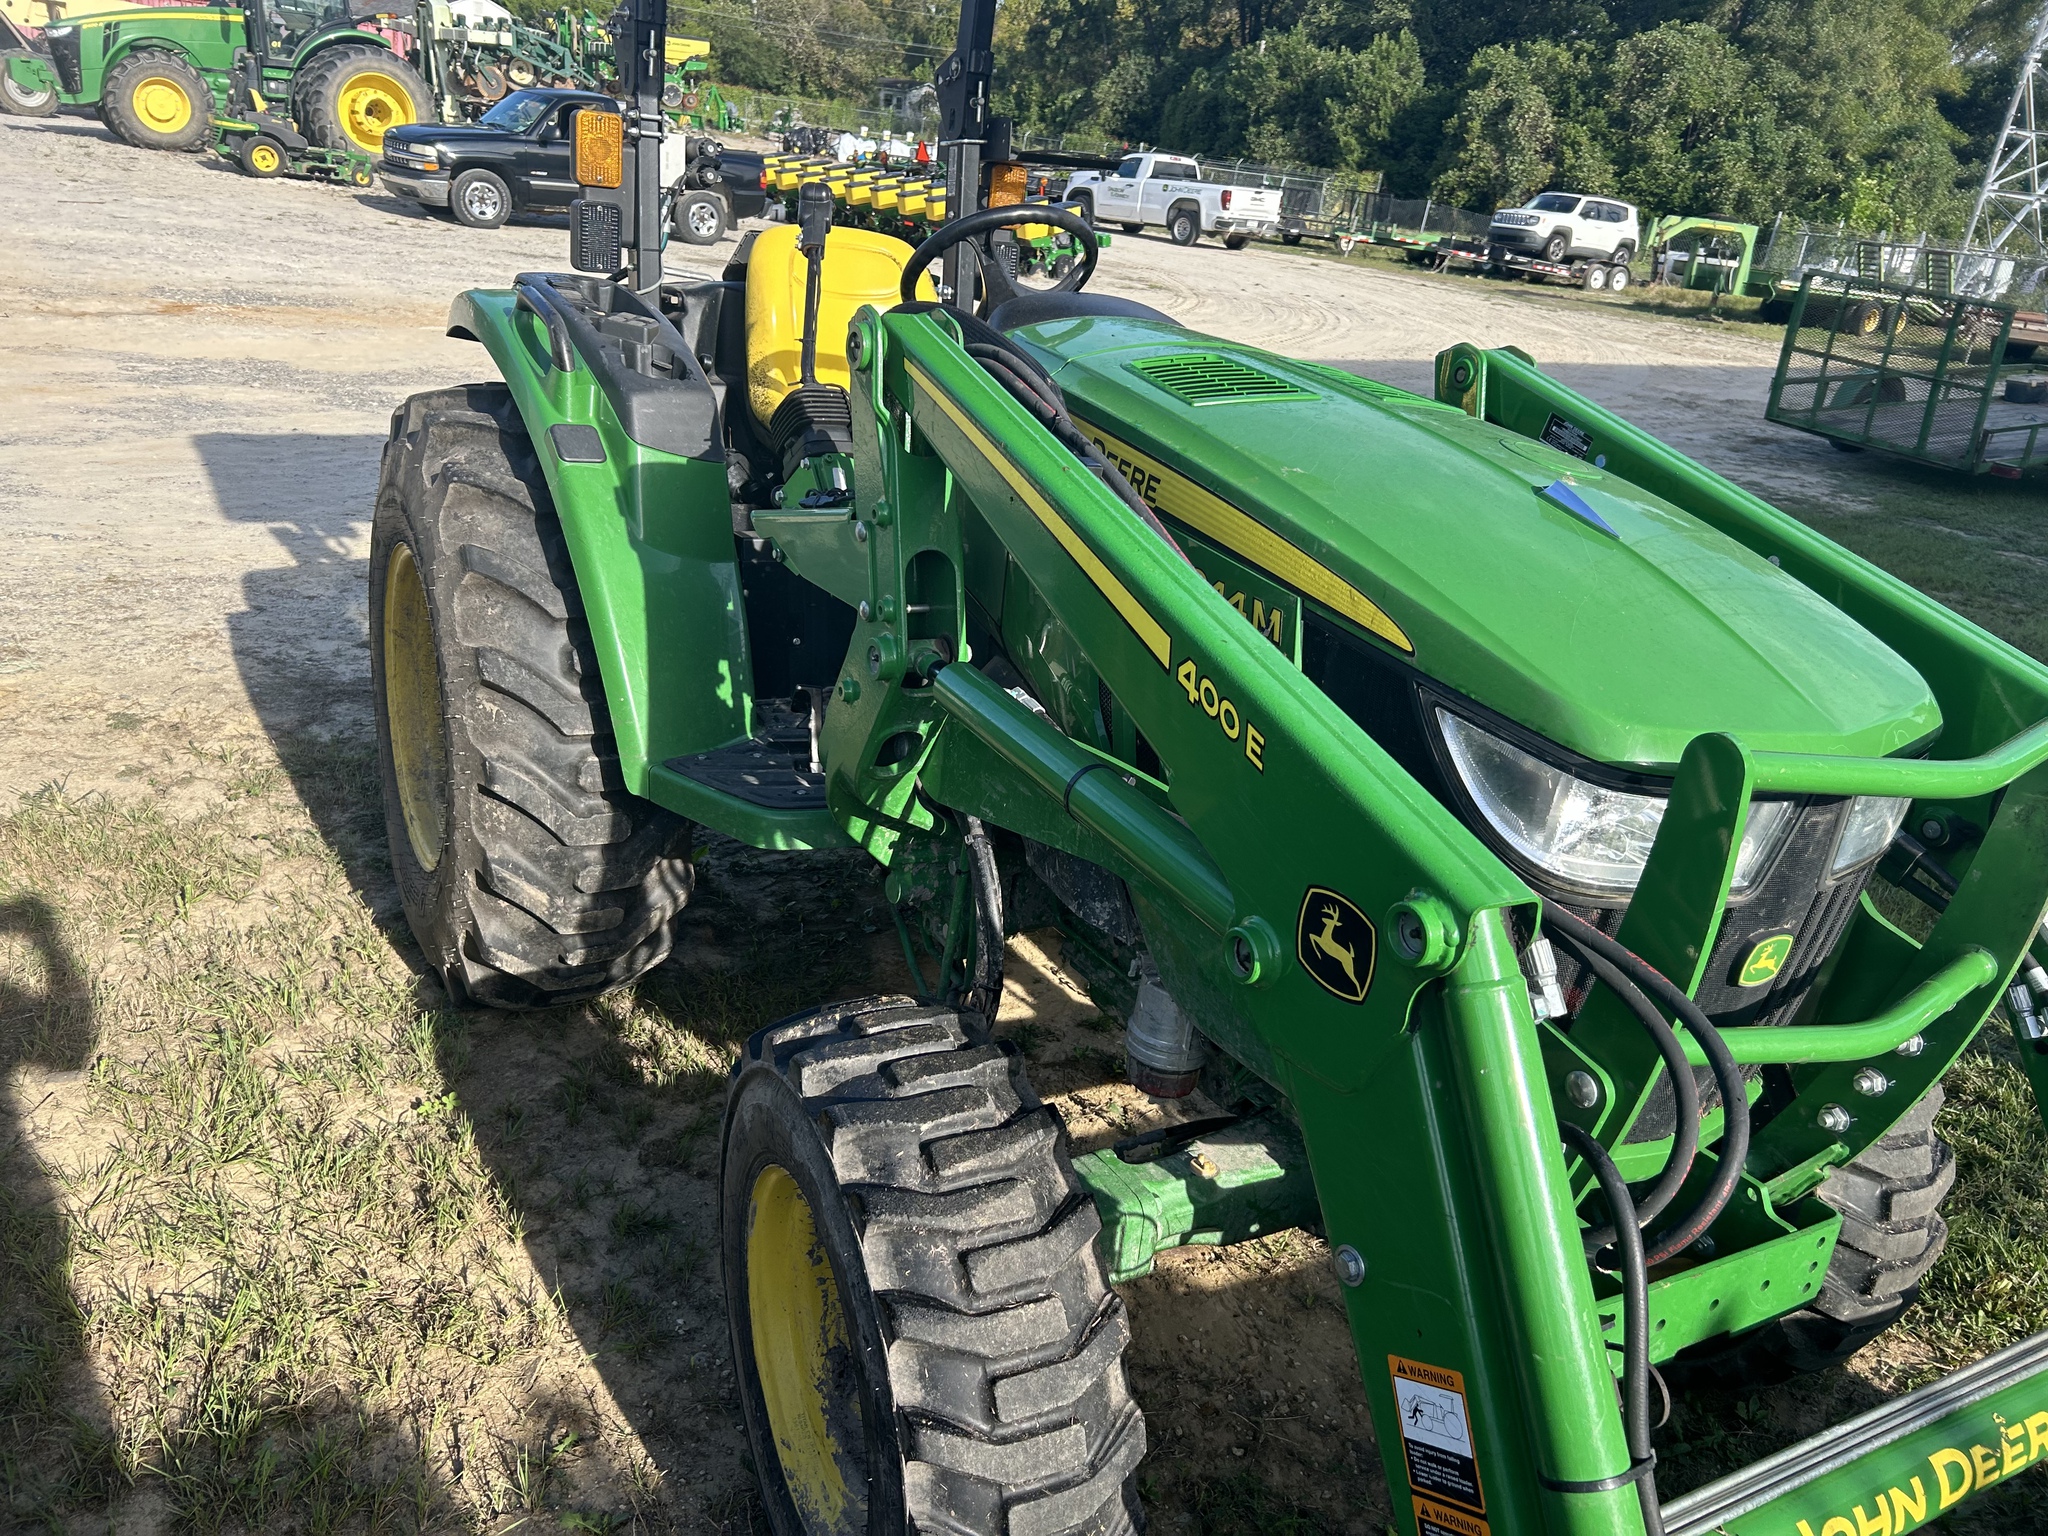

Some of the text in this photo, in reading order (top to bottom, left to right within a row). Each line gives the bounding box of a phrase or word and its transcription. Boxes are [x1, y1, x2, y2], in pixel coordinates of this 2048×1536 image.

[1177, 658, 1265, 775] 400 E
[1691, 1200, 1723, 1235] Resistant
[1407, 1365, 1455, 1388] WARNING
[1433, 1507, 1482, 1536] WARNING
